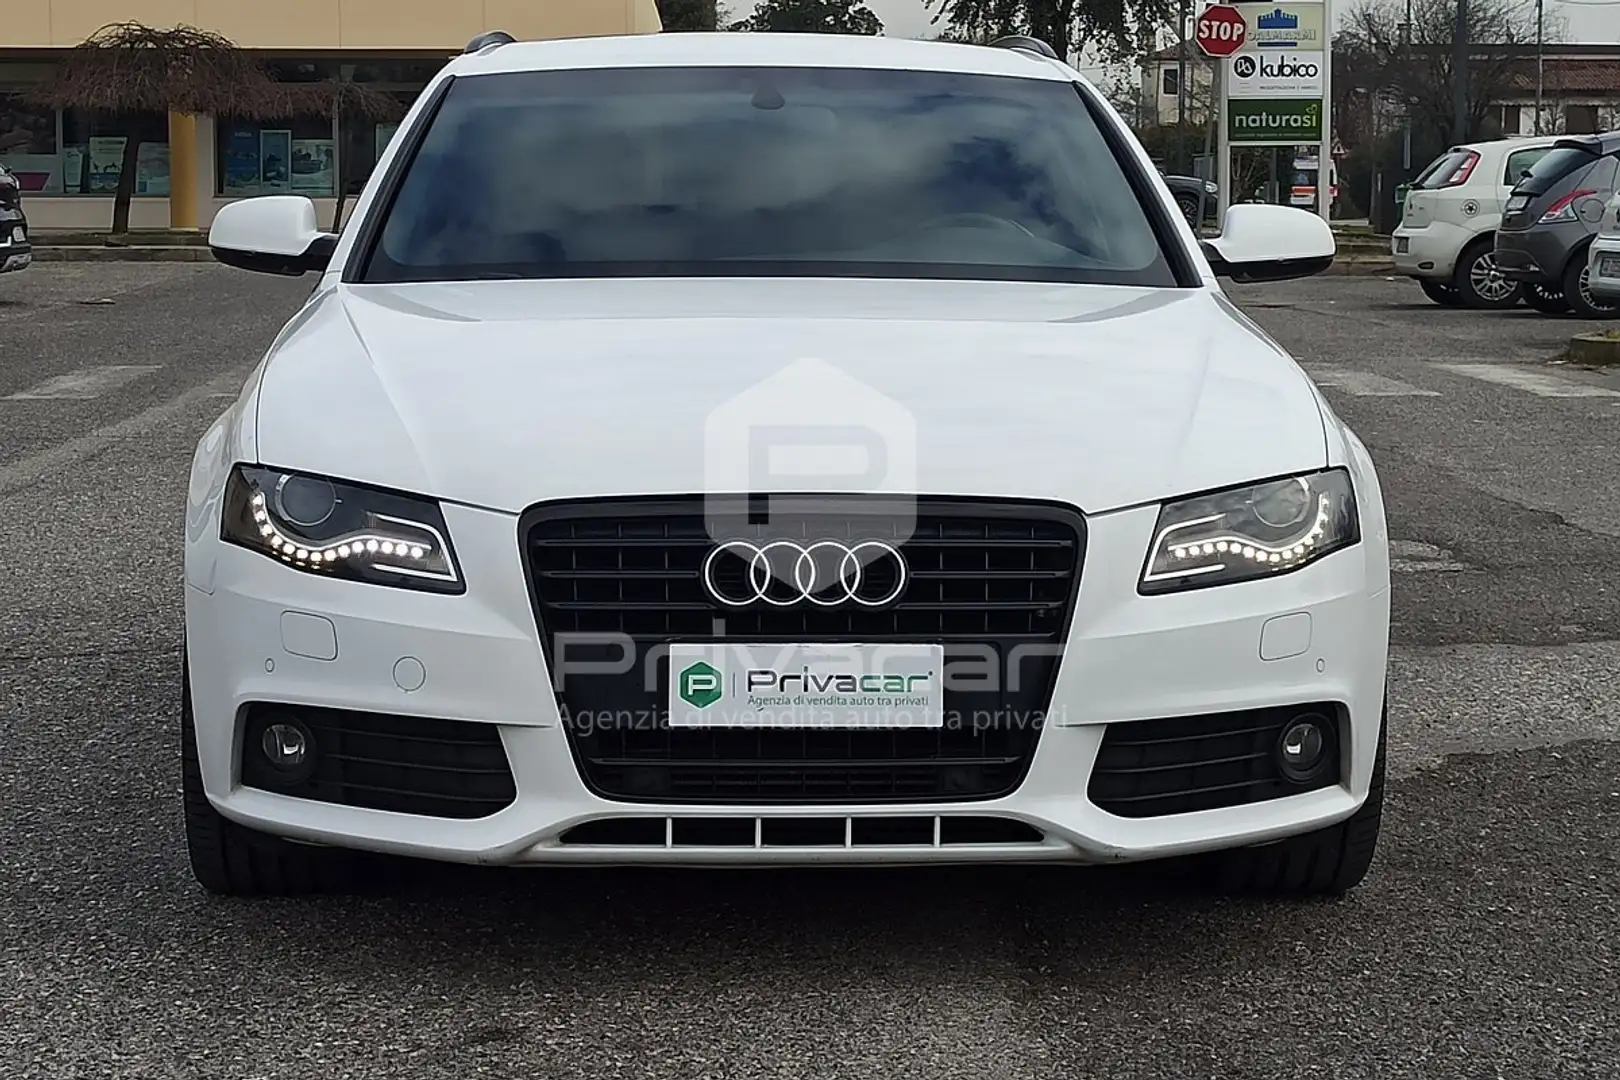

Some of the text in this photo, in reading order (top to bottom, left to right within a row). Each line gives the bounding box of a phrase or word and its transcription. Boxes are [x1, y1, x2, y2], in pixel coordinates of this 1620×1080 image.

[1198, 20, 1244, 41] STOP
[1259, 55, 1318, 77] kubico
[747, 666, 929, 693] Privacar
[747, 694, 929, 709] Agenzia di vendita auto tra privati
